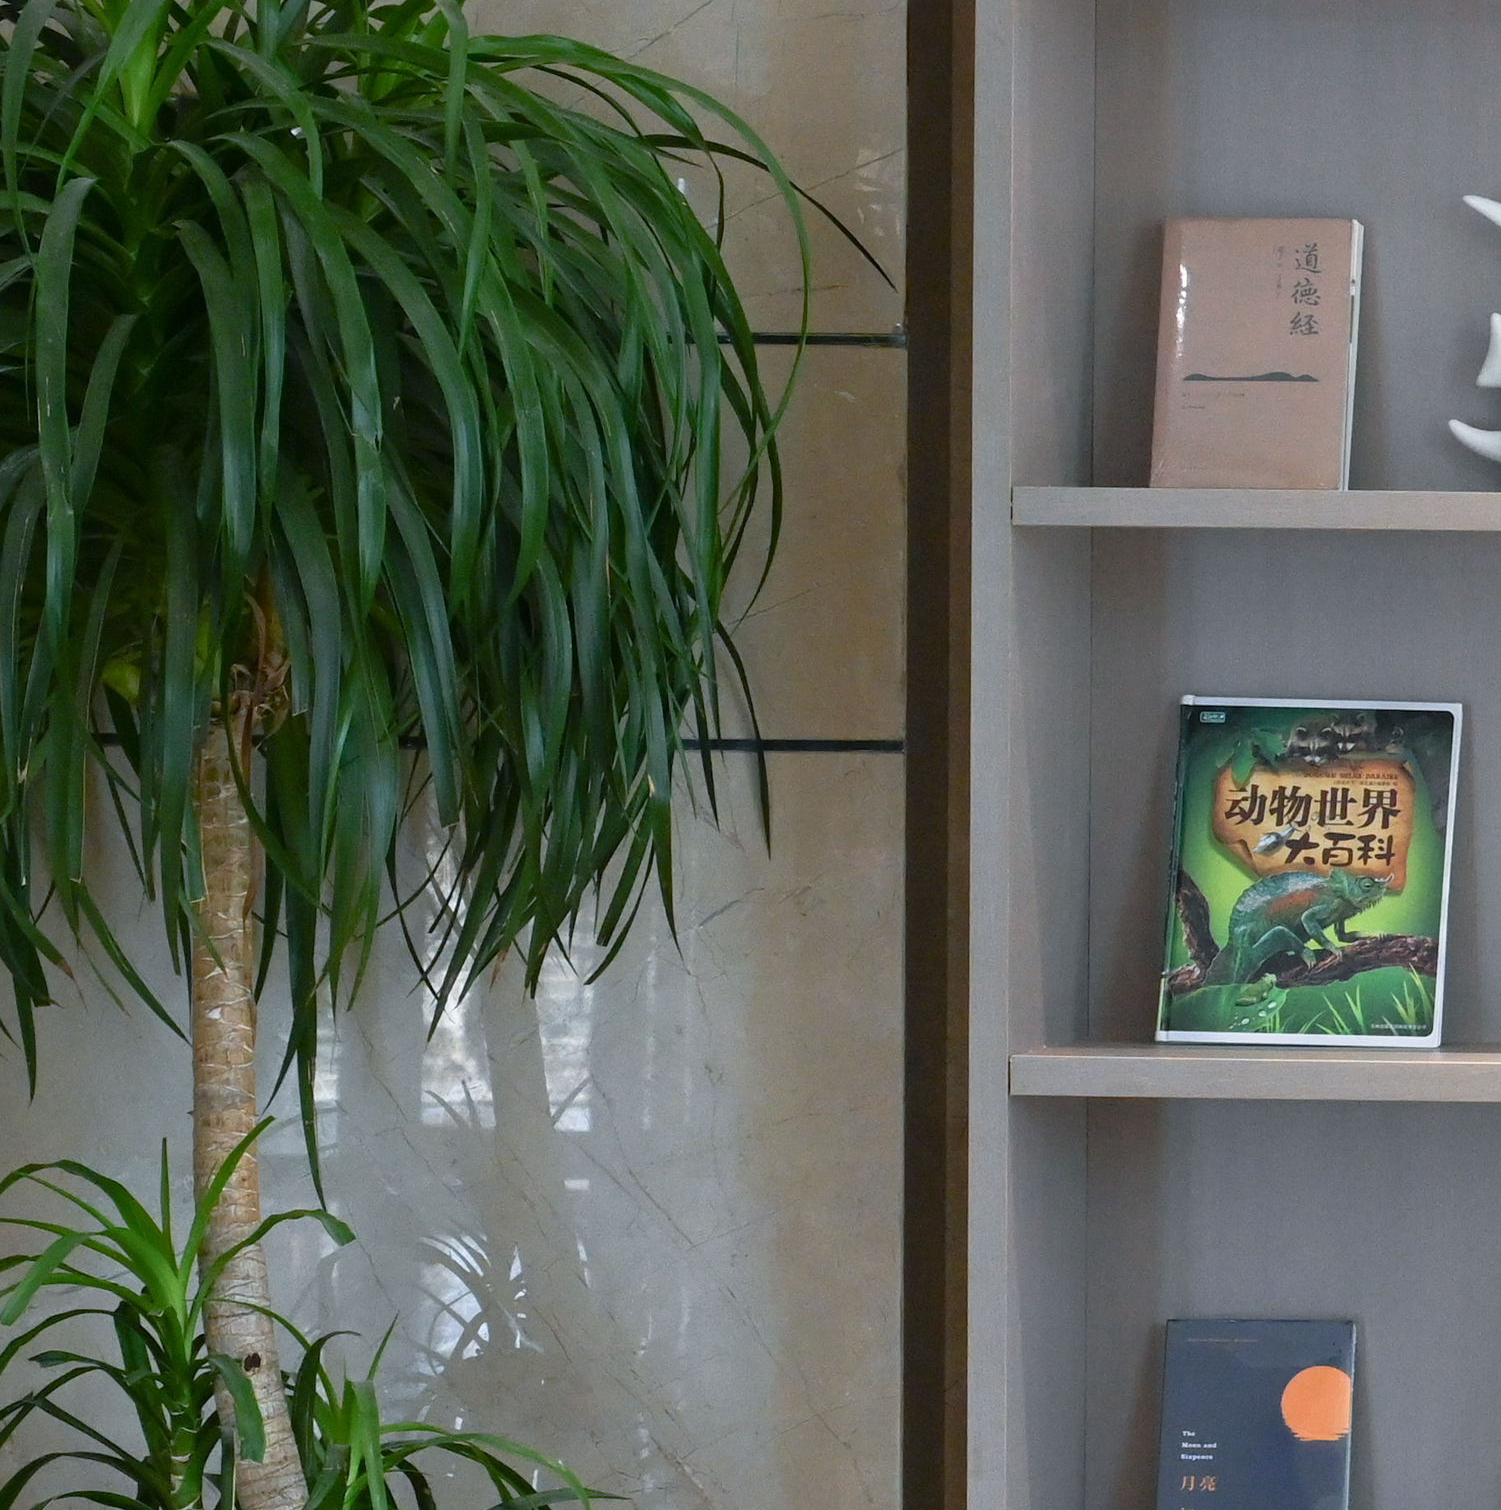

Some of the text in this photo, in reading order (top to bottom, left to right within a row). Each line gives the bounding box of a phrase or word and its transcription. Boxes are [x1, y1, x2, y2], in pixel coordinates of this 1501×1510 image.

[1224, 783, 1402, 829] 动物世界
[1284, 832, 1395, 867] 大百科
[1180, 1453, 1214, 1461] Sixpence
[1180, 1475, 1218, 1492] 月亮
